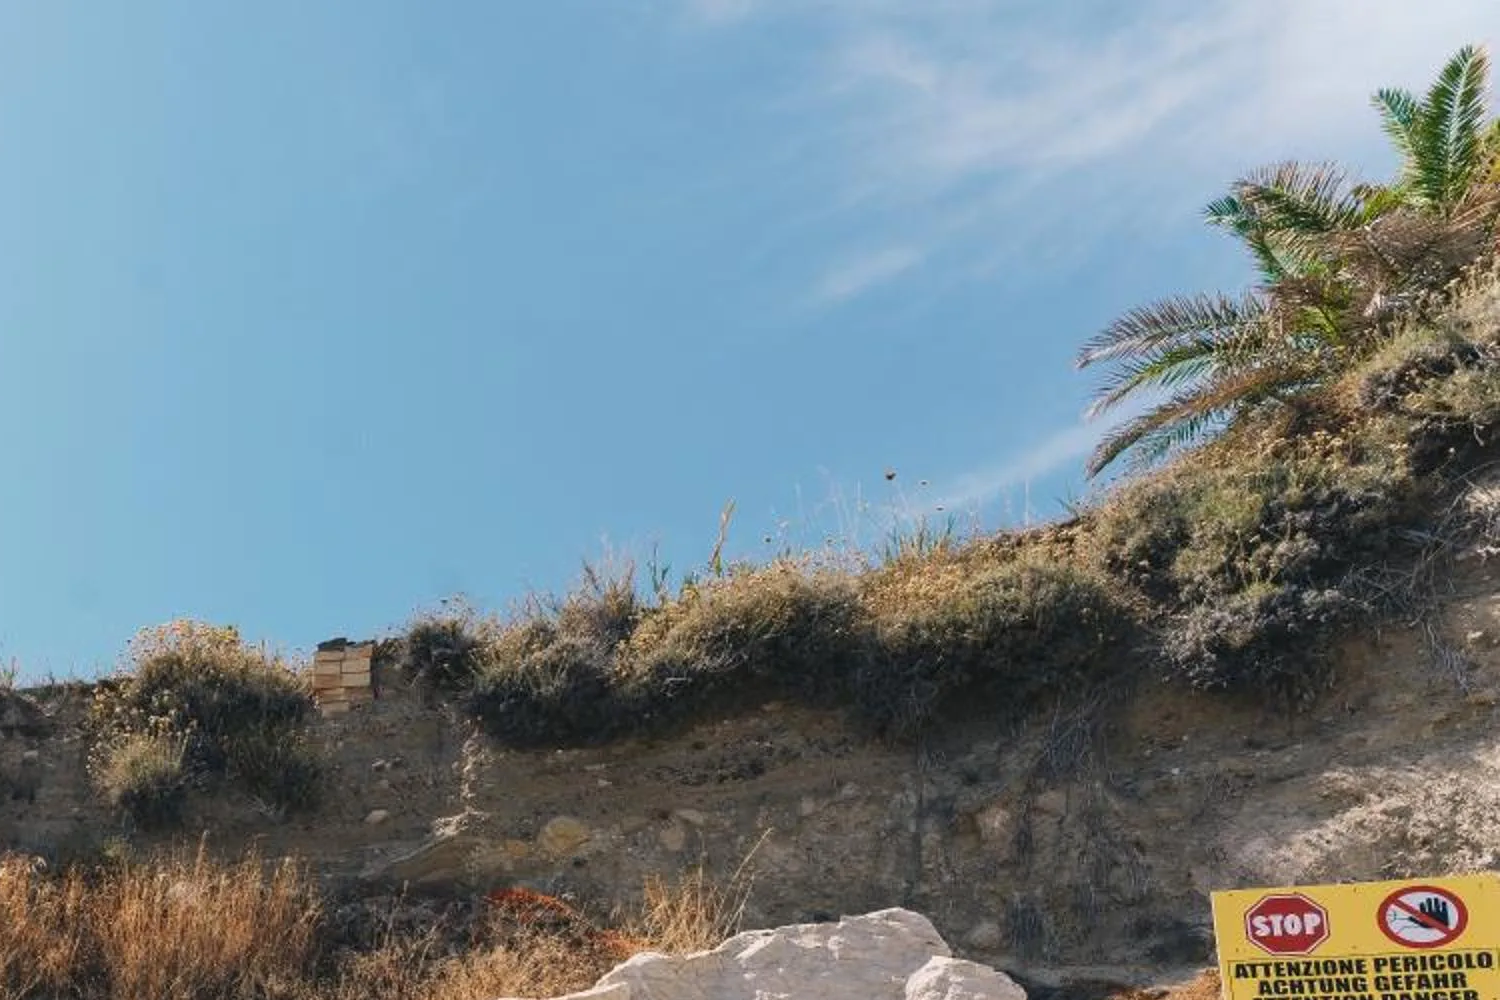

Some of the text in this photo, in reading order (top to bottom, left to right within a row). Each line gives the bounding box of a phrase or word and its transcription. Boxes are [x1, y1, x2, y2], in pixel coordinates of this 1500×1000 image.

[1252, 912, 1321, 937] STOP
[1235, 952, 1493, 978] ATTENZIONE PERICOLO
[1259, 973, 1467, 995] ACHTUNG GEFAHR
